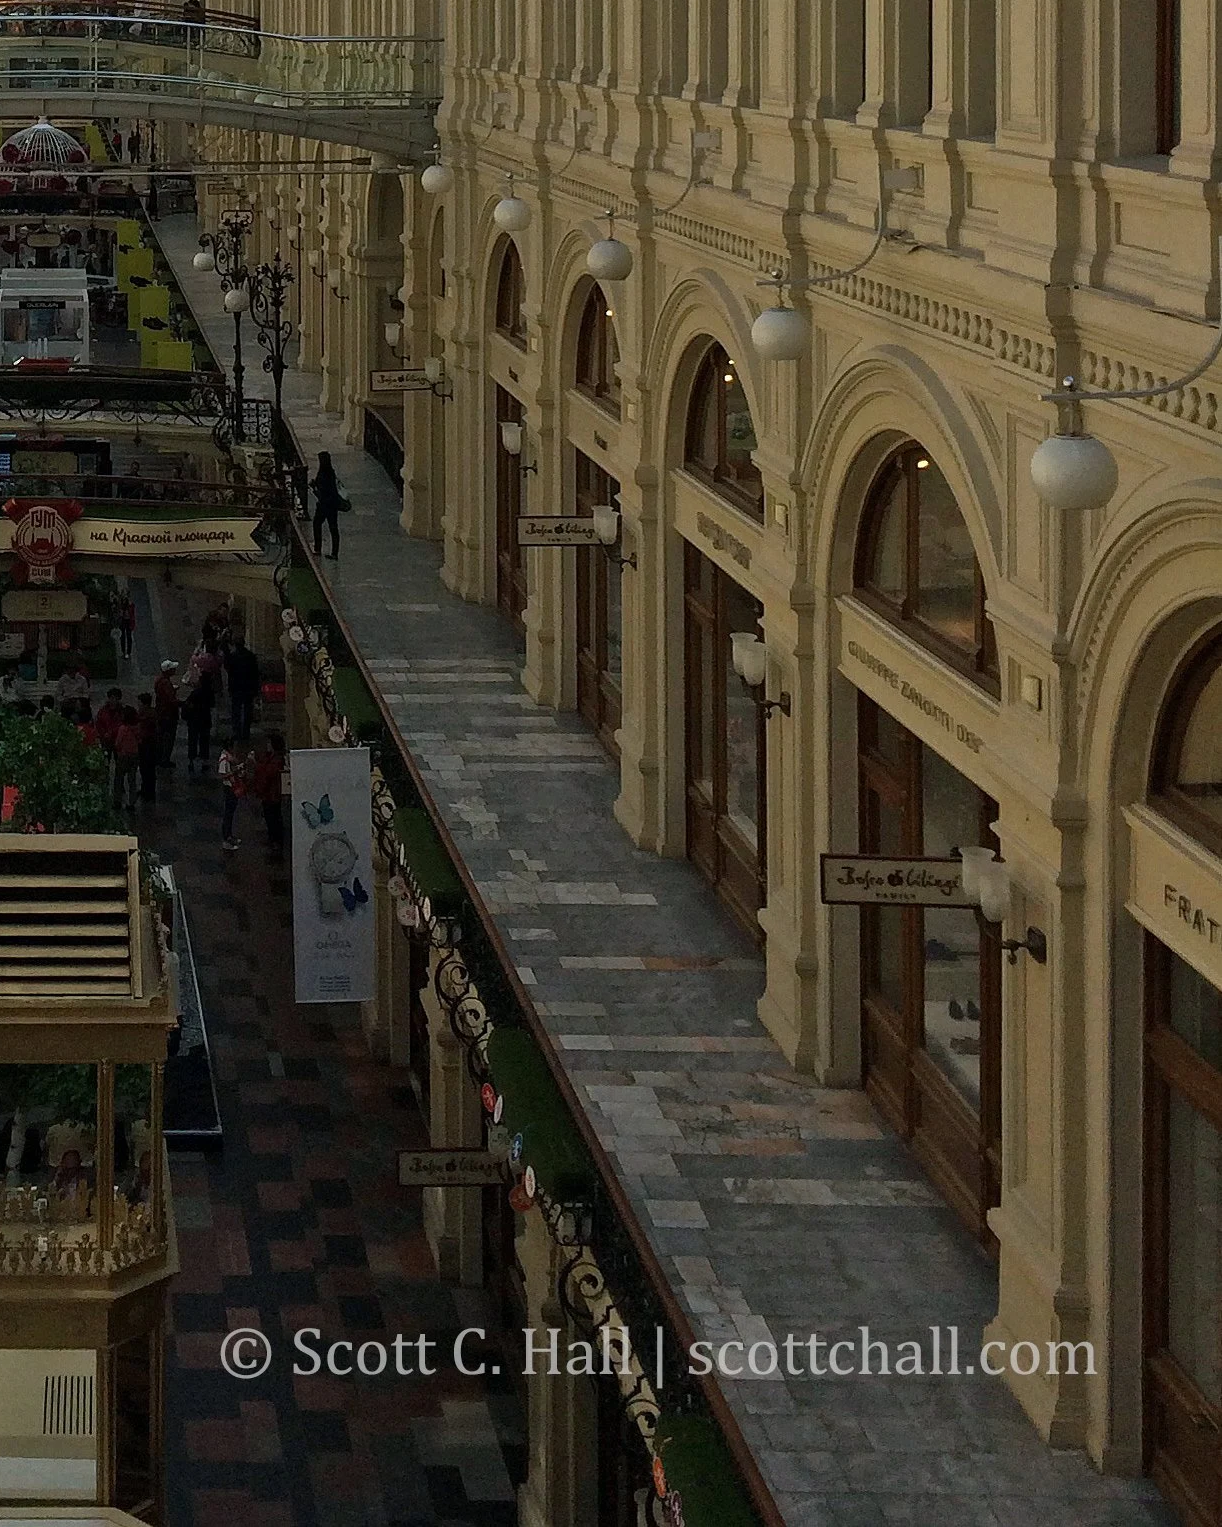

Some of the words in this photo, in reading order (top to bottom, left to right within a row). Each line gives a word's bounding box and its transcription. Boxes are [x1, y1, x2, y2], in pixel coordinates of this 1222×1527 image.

[90, 531, 108, 542] на
[112, 527, 172, 547] Красной
[174, 530, 235, 545] площади
